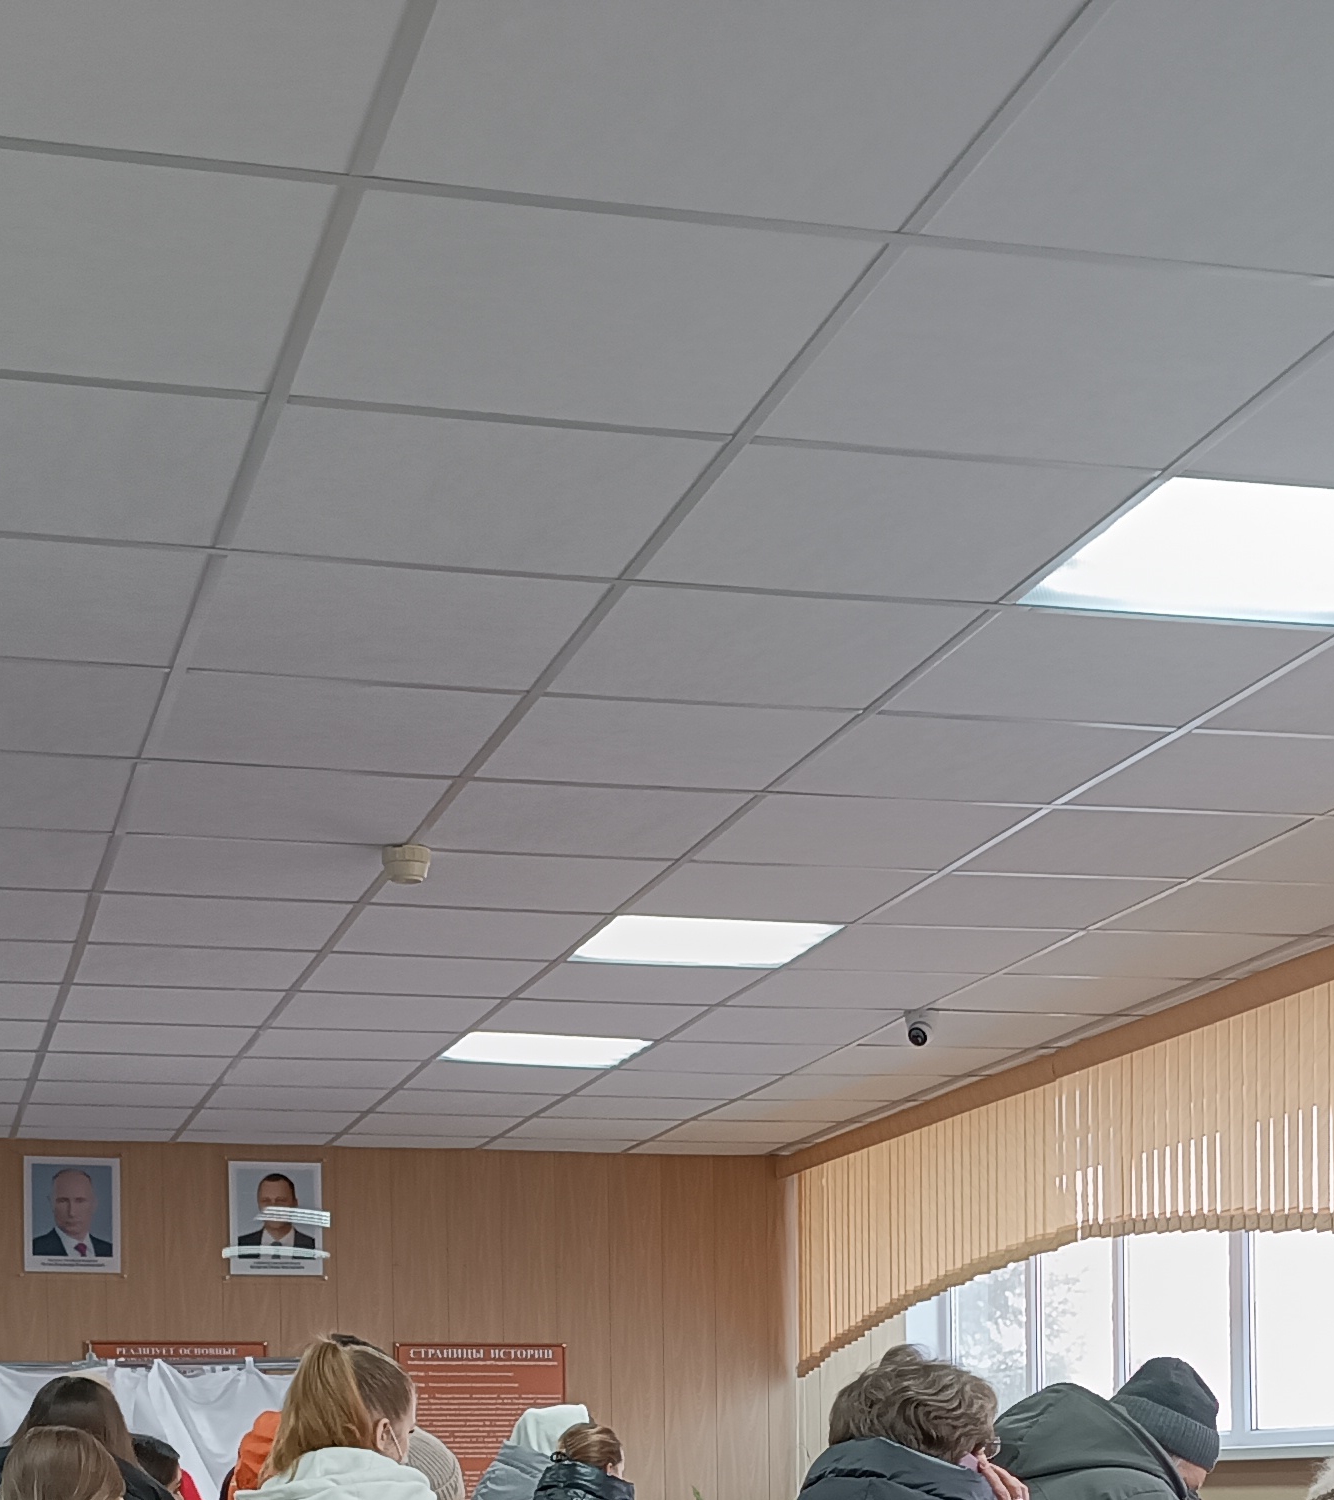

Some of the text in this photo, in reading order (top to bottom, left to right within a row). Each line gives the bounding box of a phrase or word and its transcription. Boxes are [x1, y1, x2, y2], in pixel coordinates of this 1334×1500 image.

[179, 1347, 239, 1356] ОСНОВНЫЕ
[410, 1348, 554, 1359] СТРАНИЦЫ ИСТОРИИ
